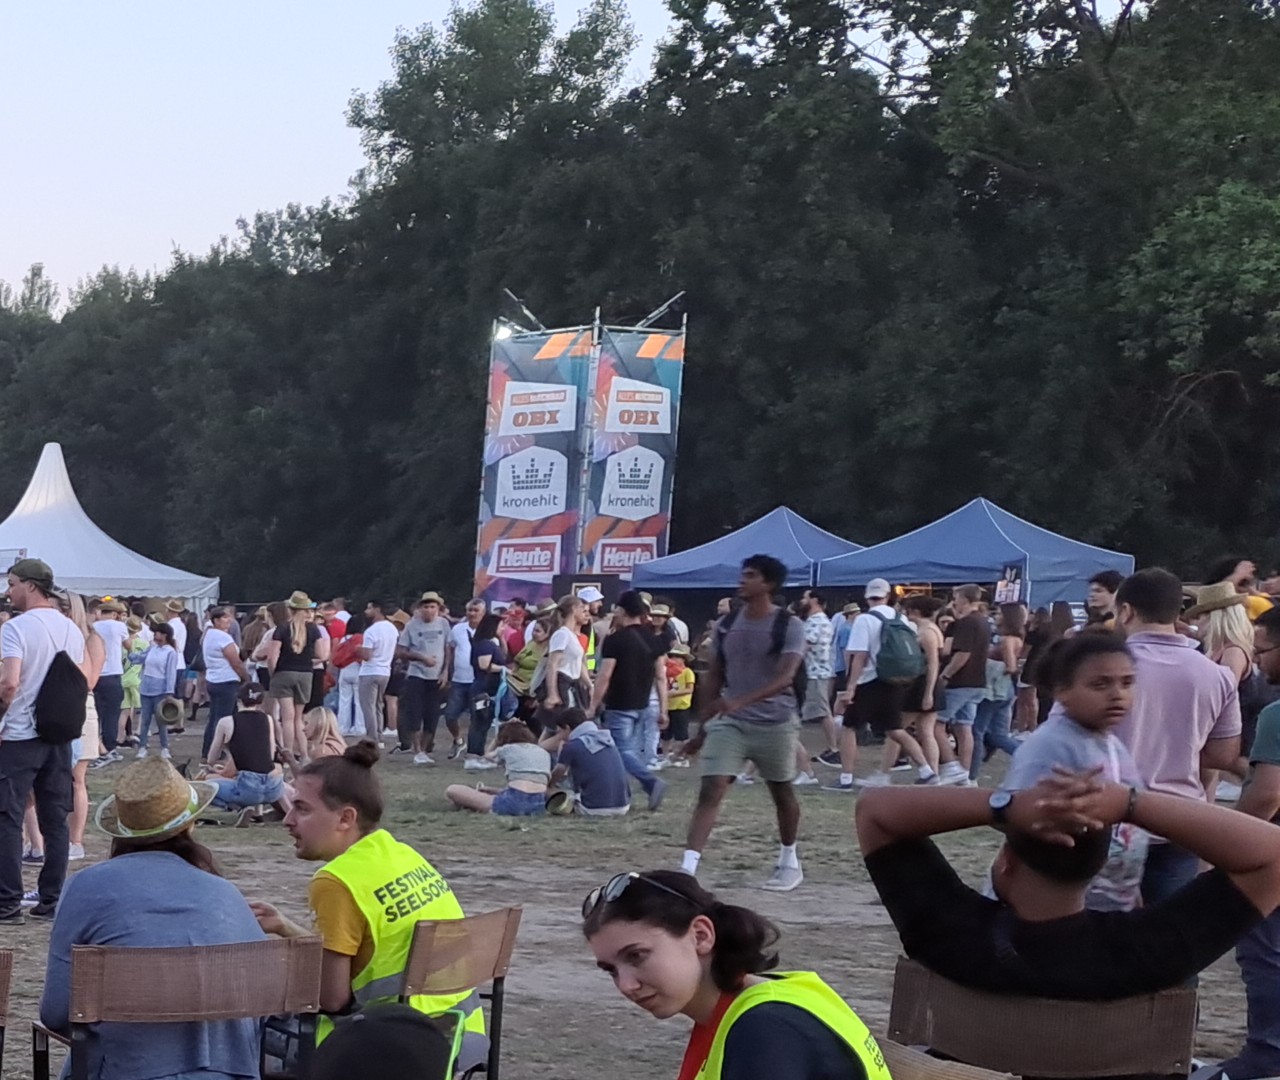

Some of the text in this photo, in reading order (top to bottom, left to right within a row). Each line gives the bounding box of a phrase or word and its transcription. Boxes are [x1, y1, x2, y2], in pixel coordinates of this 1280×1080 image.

[512, 410, 560, 427] OBI
[618, 410, 660, 425] OBI
[502, 495, 558, 508] kronehit
[608, 494, 655, 508] kronehit
[499, 547, 552, 567] Heute
[604, 547, 651, 566] Heute
[373, 863, 436, 906] FESTIVAL
